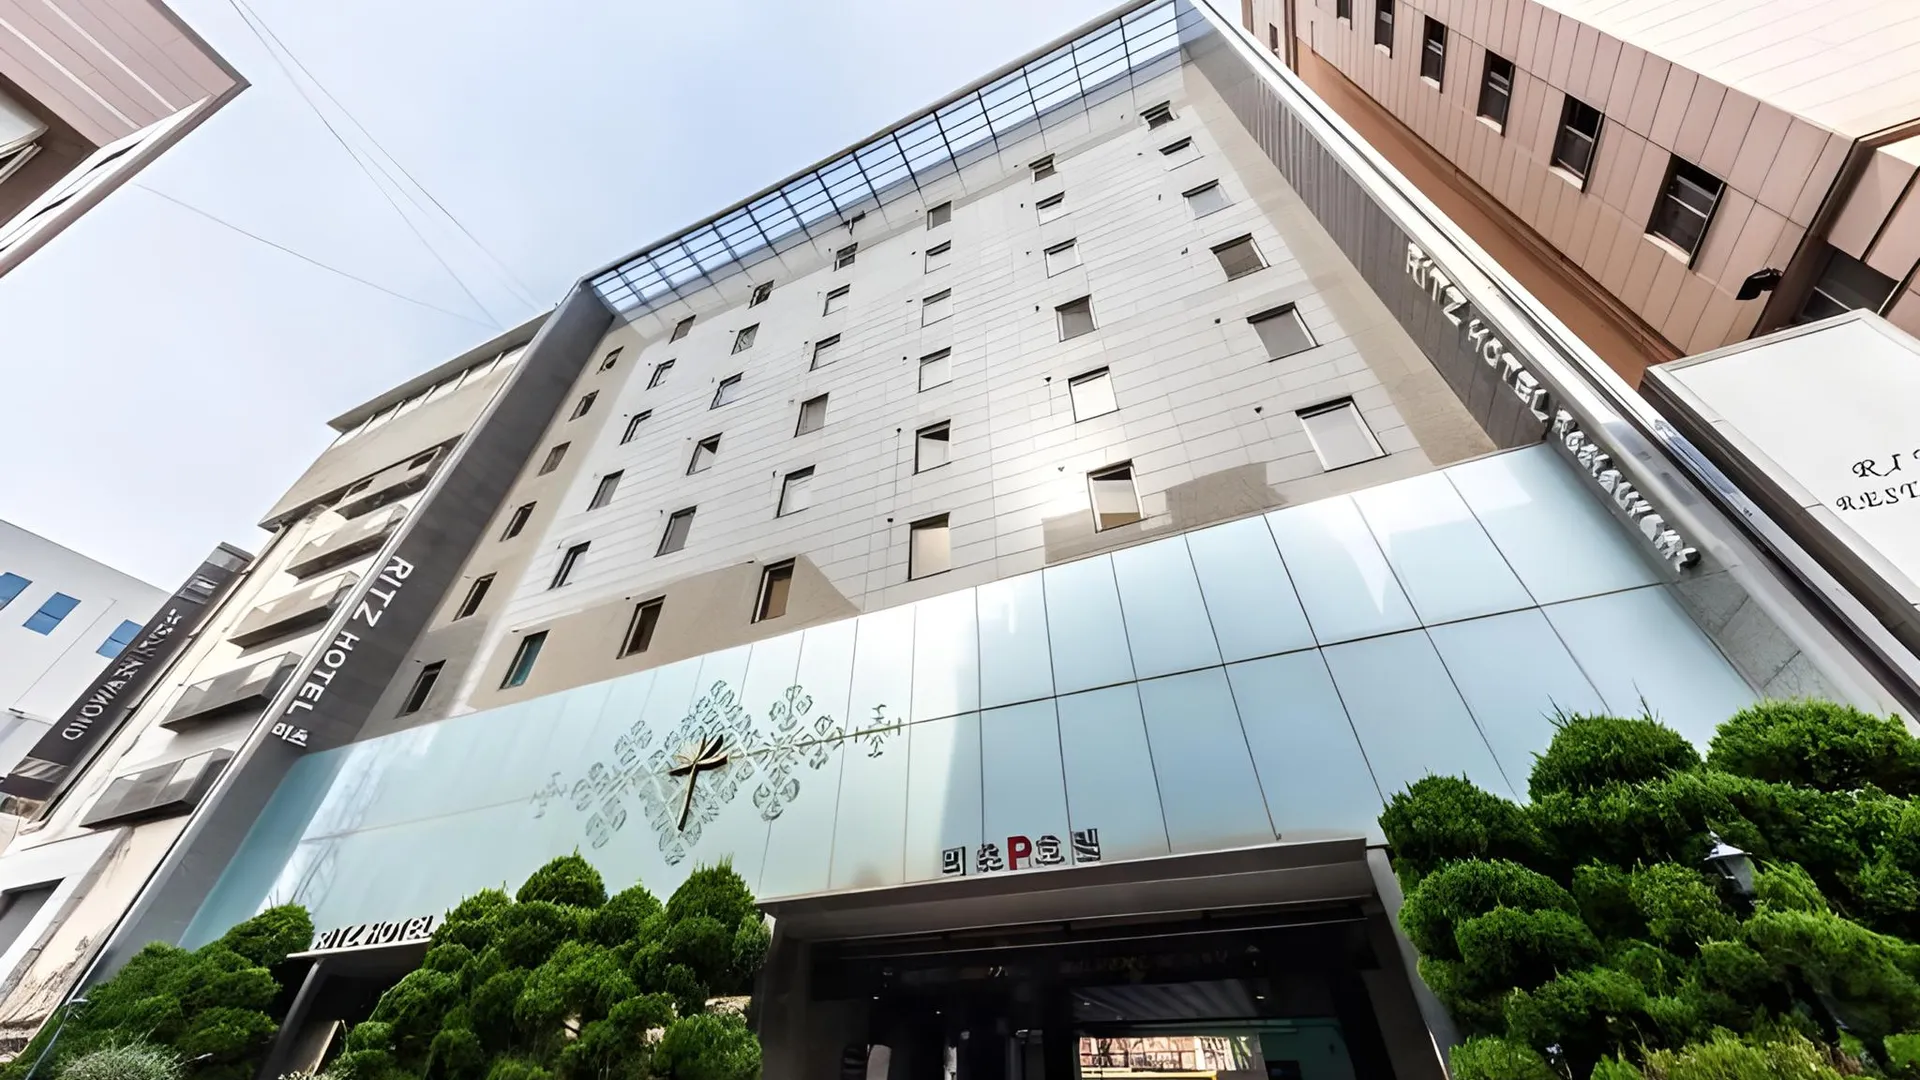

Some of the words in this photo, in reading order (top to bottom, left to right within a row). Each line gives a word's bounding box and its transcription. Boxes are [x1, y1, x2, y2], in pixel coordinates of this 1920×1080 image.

[1405, 241, 1468, 327] RITZ
[1467, 316, 1551, 422] HOTEL
[353, 555, 414, 628] RITZ
[286, 631, 361, 715] HOTEL
[312, 922, 367, 950] RITZ
[365, 914, 434, 945] HOTEL
